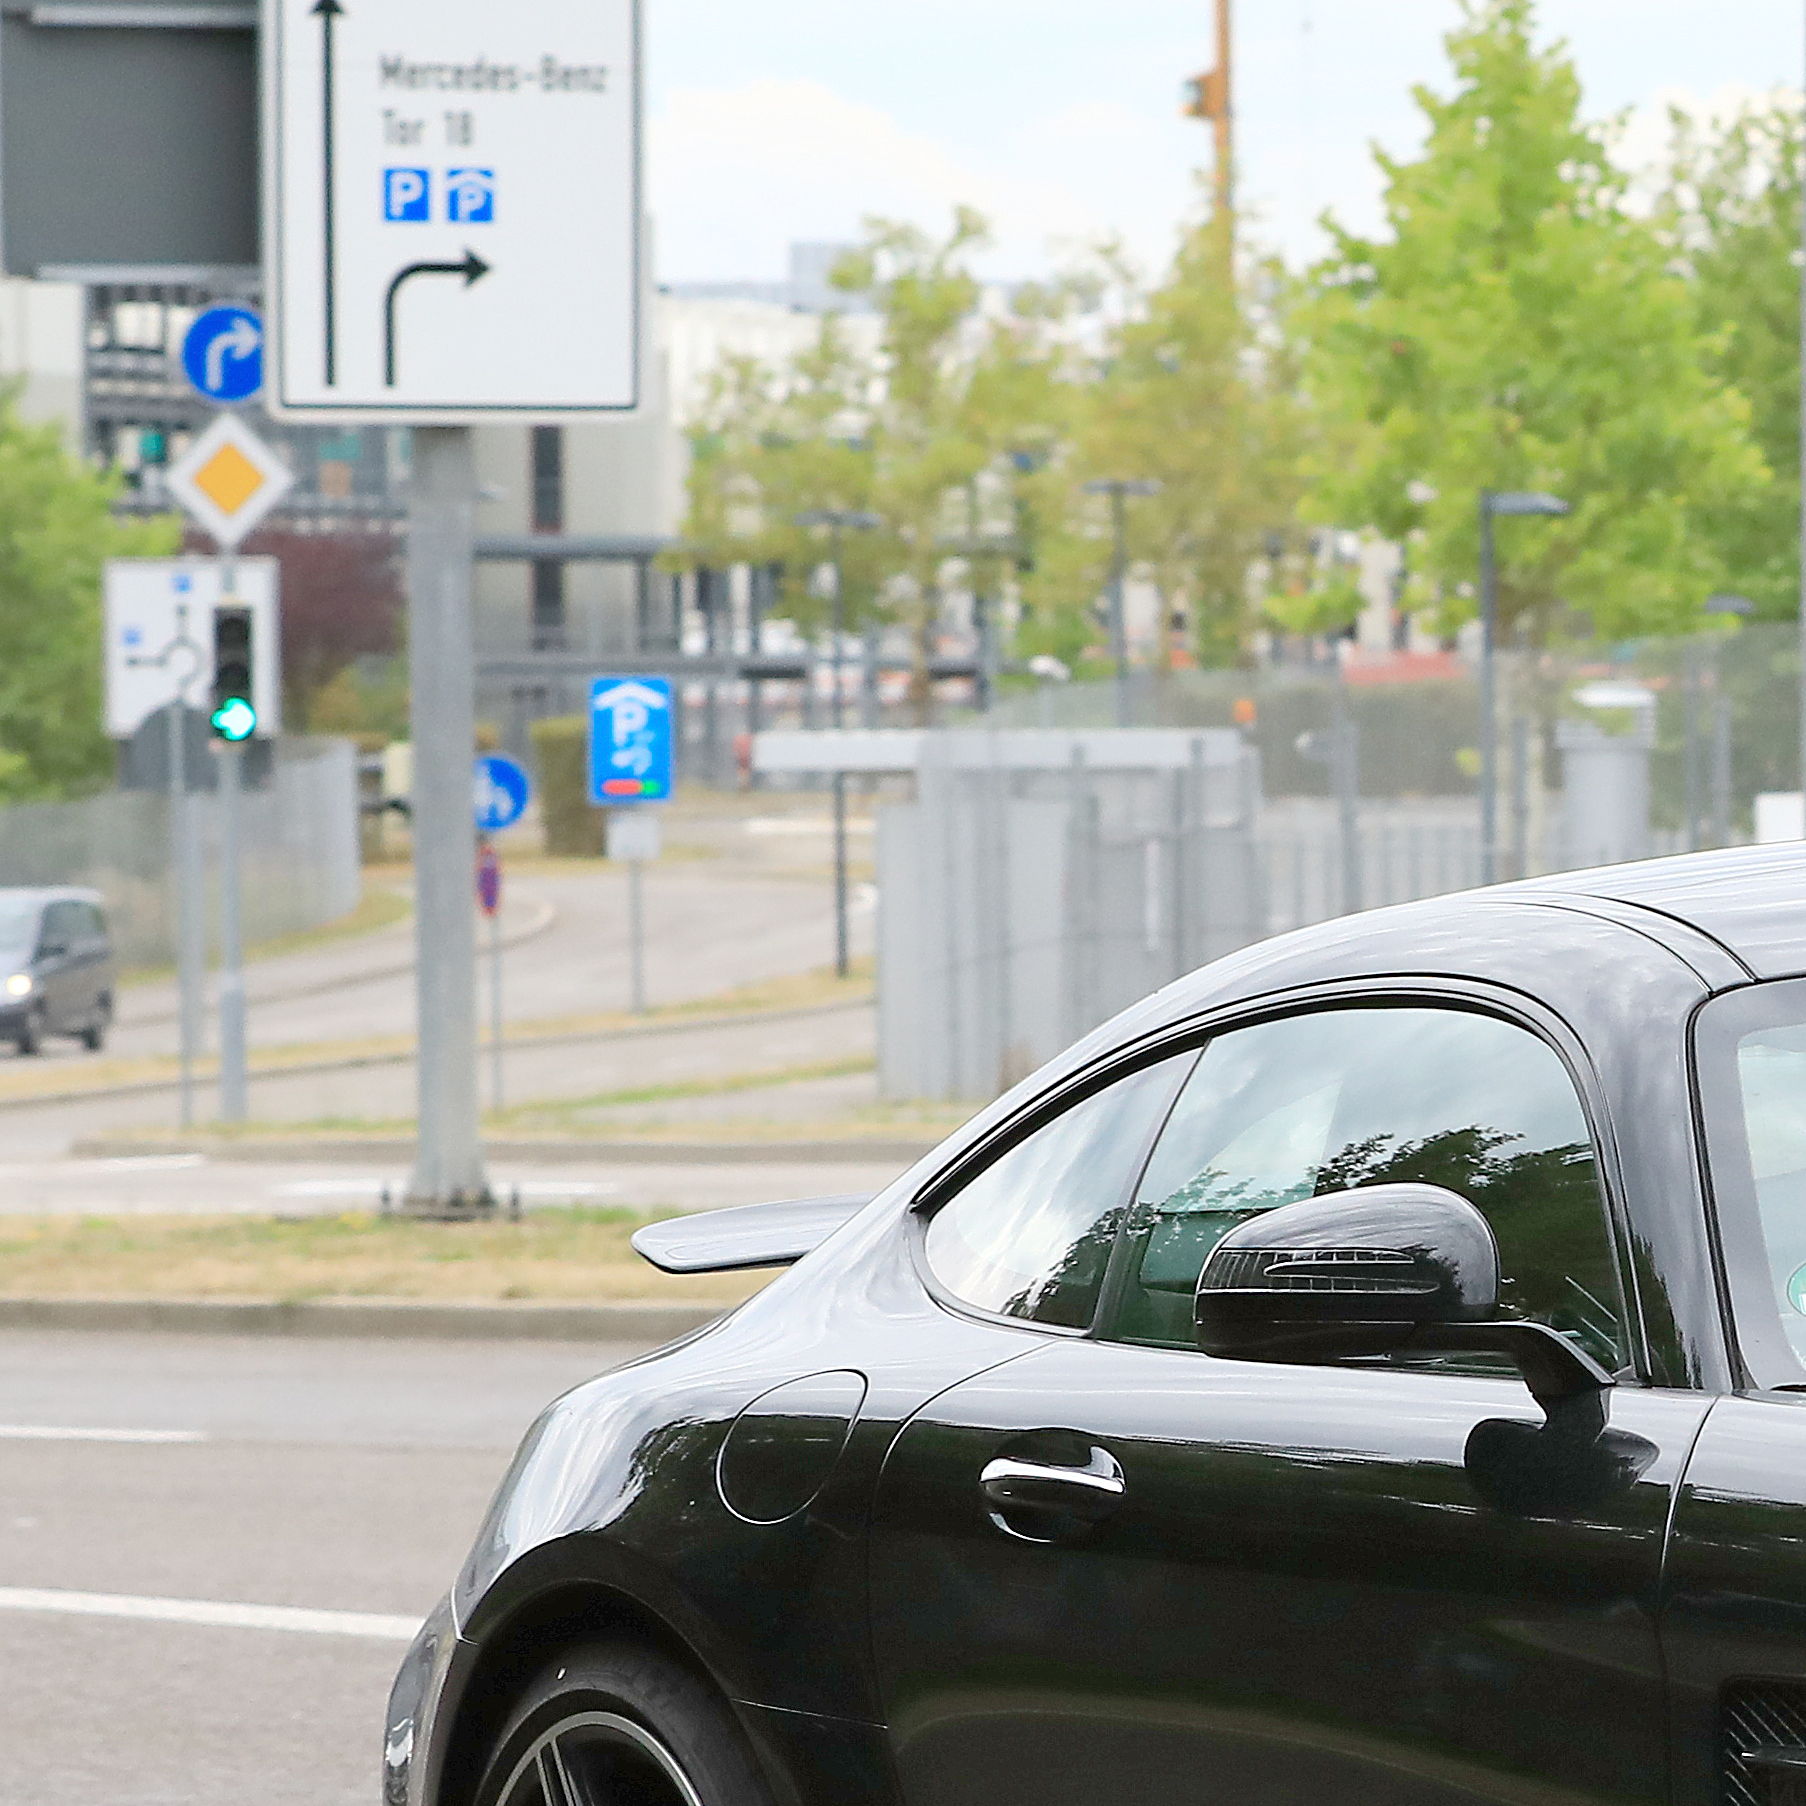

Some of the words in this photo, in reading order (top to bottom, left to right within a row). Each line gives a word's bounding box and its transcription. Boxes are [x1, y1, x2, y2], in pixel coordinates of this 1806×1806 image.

[379, 53, 606, 91] Mercedes-Benz
[381, 109, 424, 145] Tor
[444, 110, 474, 147] 18
